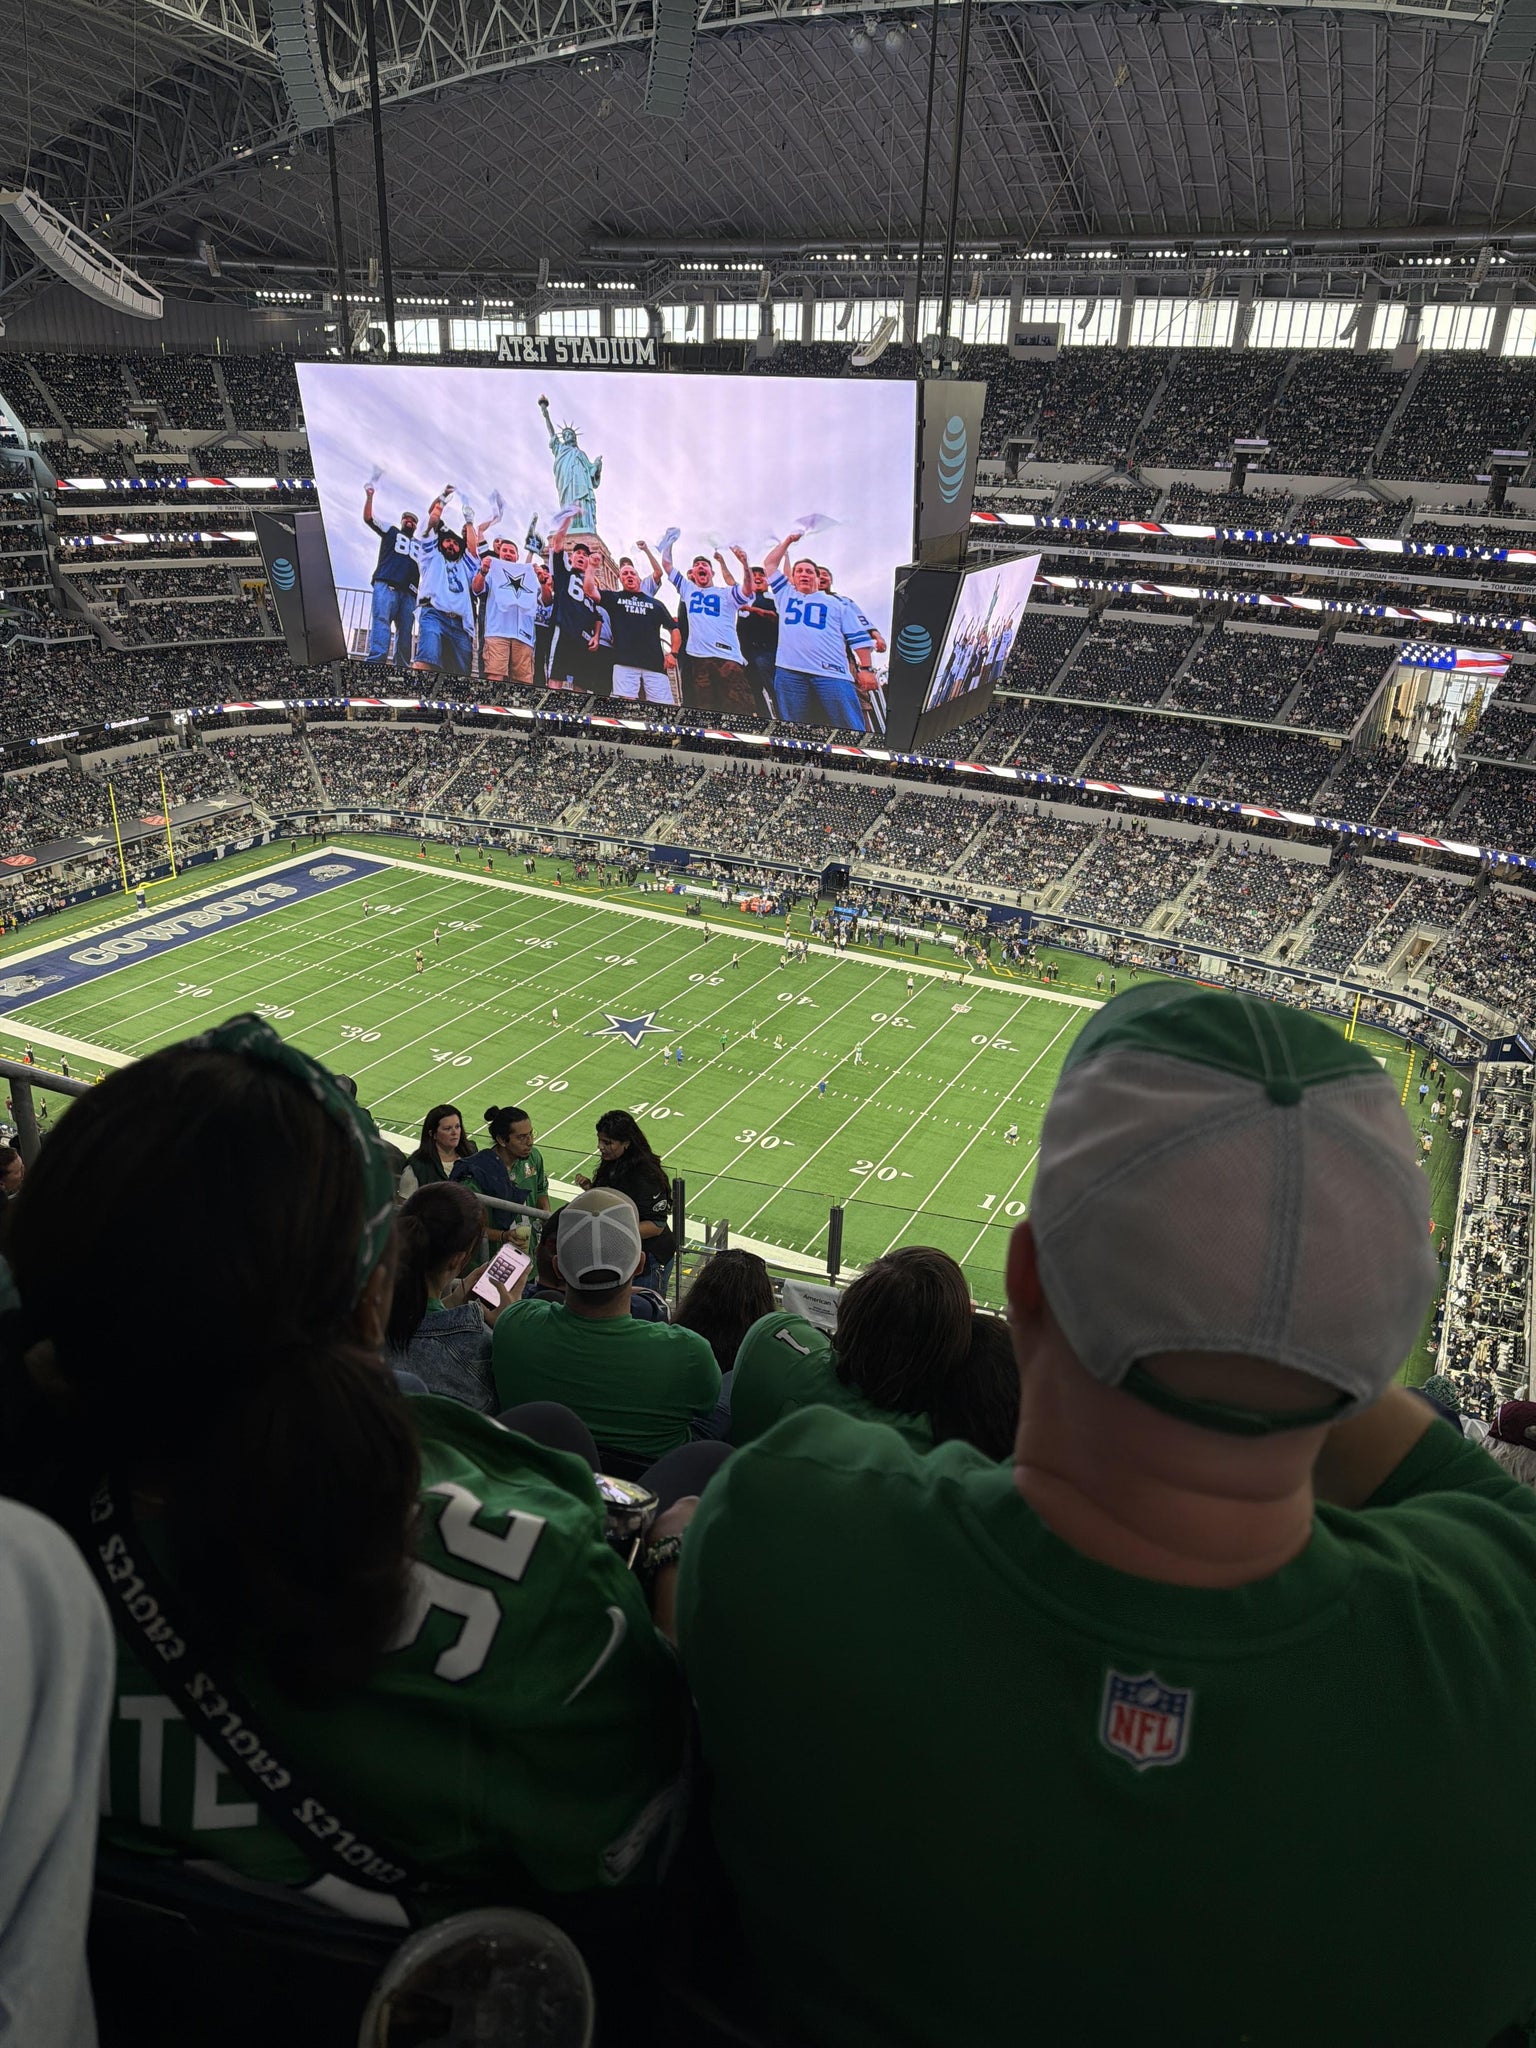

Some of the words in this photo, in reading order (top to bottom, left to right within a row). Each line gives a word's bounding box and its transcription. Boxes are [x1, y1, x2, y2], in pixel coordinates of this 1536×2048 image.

[498, 336, 549, 363] AT&T
[554, 337, 656, 365] STADIUM
[1215, 559, 1244, 567] STAUBACH
[1363, 572, 1387, 580] JORDAN
[1491, 583, 1506, 591] TOM
[1507, 585, 1536, 593] LANDRY
[625, 605, 647, 615] TEAM
[689, 591, 720, 617] 29
[784, 597, 828, 630] 50
[62, 932, 82, 944] IT
[87, 913, 143, 935] TAKES
[147, 898, 182, 914] ALL
[185, 893, 201, 903] OF
[208, 883, 230, 893] US
[374, 904, 407, 915] 10
[69, 882, 298, 966] COWBOYS
[447, 920, 483, 932] 20
[524, 937, 558, 949] 30
[604, 955, 638, 967] 40
[688, 973, 725, 986] 50
[175, 983, 213, 998] 10
[777, 993, 813, 1005] 40
[253, 1004, 295, 1020] 20
[871, 1013, 909, 1027] 30
[340, 1026, 382, 1043] 30
[971, 1034, 1012, 1050] 20
[432, 1050, 473, 1067] 40
[526, 1074, 570, 1093] 50
[628, 1101, 671, 1120] 40
[734, 1129, 781, 1149] 30
[848, 1159, 898, 1182] 20
[977, 1193, 1026, 1217] 10
[803, 1294, 832, 1306] American
[99, 1533, 186, 1662] EAGLES
[185, 1672, 291, 1792] EAGLES
[1111, 1704, 1175, 1756] NFL
[292, 1797, 407, 1883] EAGLES
